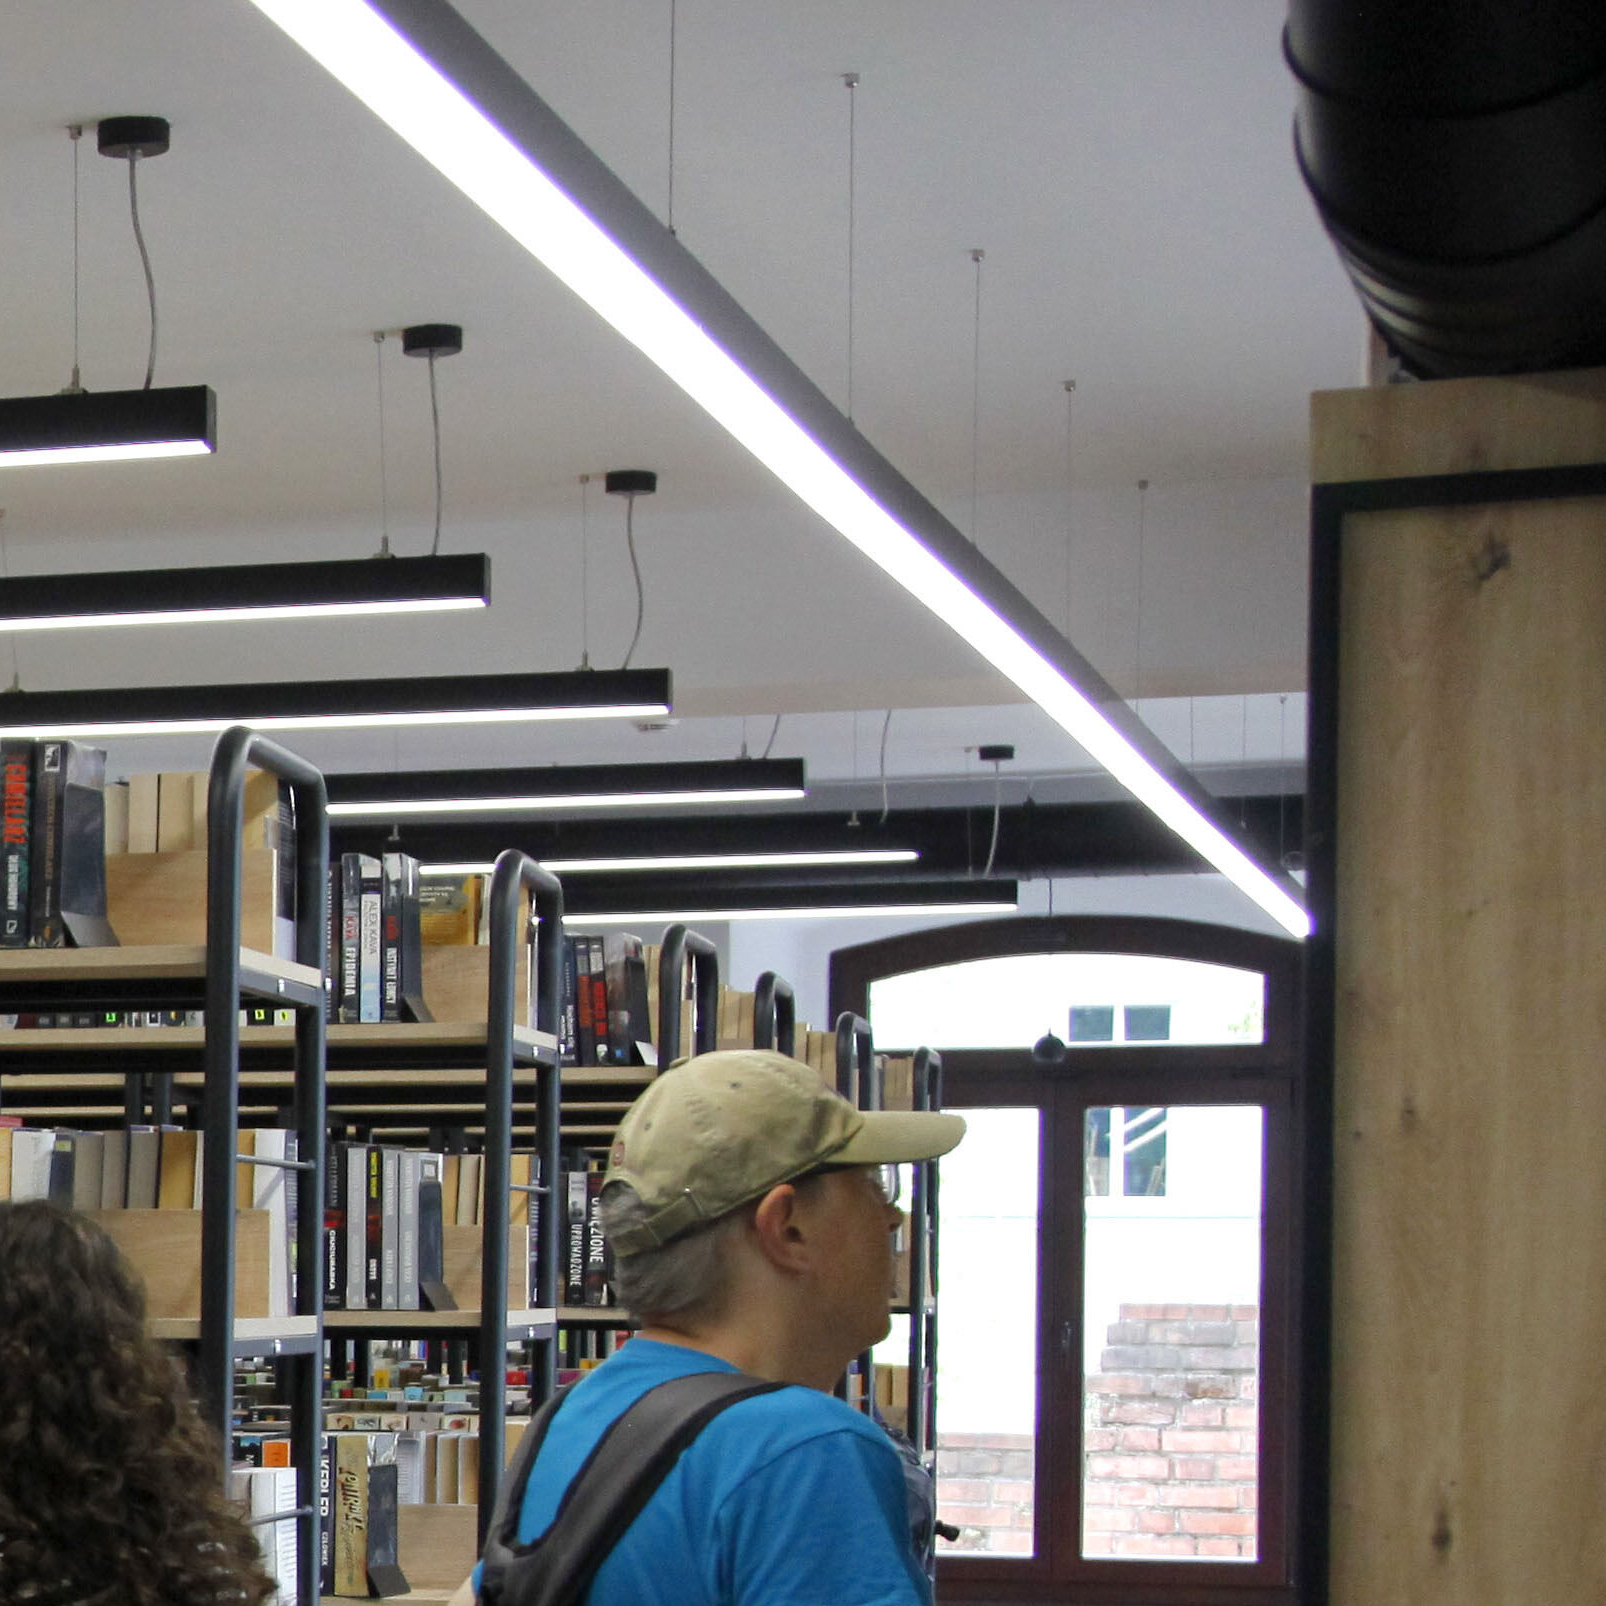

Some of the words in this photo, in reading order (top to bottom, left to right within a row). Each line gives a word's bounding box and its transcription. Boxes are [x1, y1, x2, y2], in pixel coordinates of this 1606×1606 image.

[369, 901, 379, 926] ALEX
[369, 929, 379, 955] KAVA
[570, 1224, 583, 1286] UPROWADZONE
